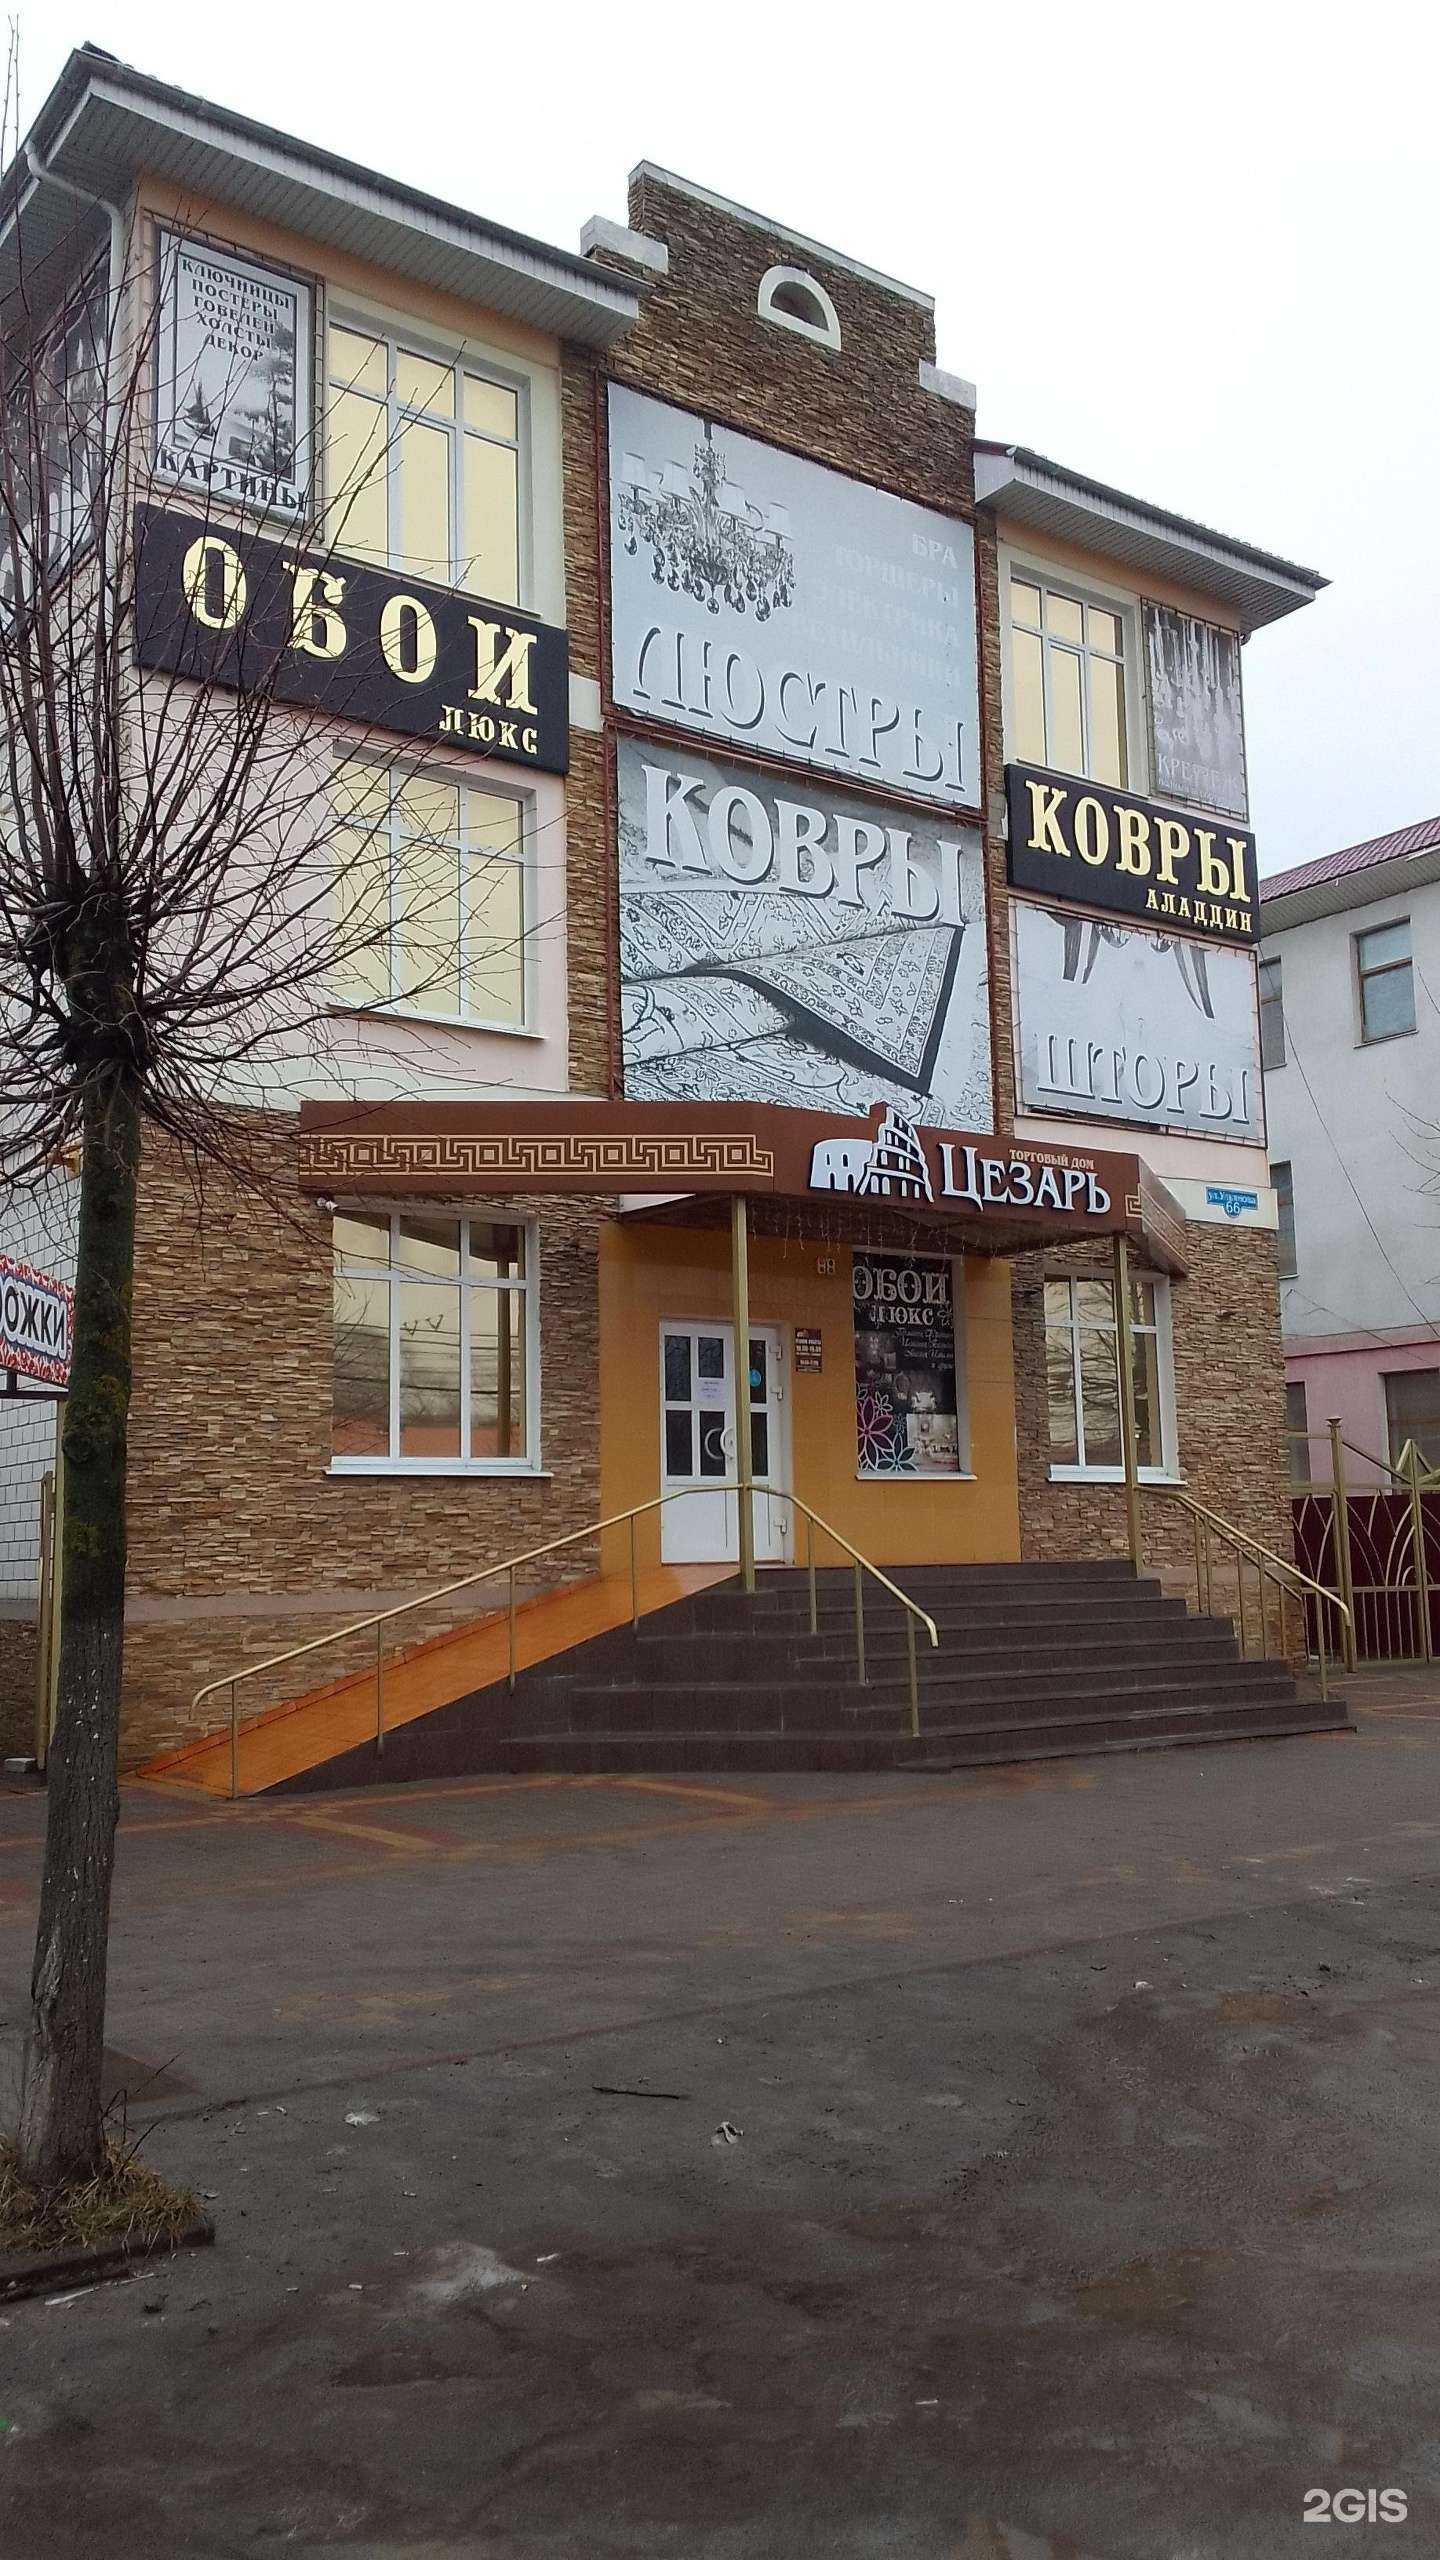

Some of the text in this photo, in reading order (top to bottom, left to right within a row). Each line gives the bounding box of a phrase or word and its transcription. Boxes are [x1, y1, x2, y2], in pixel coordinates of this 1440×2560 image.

[182, 259, 289, 309] КЛЮЧНИЦЫ
[192, 278, 278, 320] ПОСТЕРЫ
[197, 313, 271, 348] ХОЛСТЫ
[207, 334, 264, 361] ДЕКОР
[160, 446, 308, 513] КАРТИНЫ
[912, 533, 957, 569] БРА
[183, 535, 538, 715] ОБОИ
[439, 704, 538, 754] ЛЮКС
[630, 624, 966, 792] ЛЮСТРЫ
[641, 764, 966, 930] КОВРЫ
[1026, 779, 1251, 903] КОВРЫ
[1145, 888, 1253, 933] АЛАДДИН
[1034, 1032, 1250, 1124] ШТОРЫ
[938, 1142, 1111, 1214] ЦЕЗАРЬ
[1009, 1149, 1095, 1170] ТОРГОВЫЙ ДОМ
[1225, 1200, 1240, 1214] 66
[853, 1265, 950, 1304] ОБОИ
[0, 1283, 67, 1351] ОЖКИ
[870, 1305, 934, 1326] ЛЮКС
